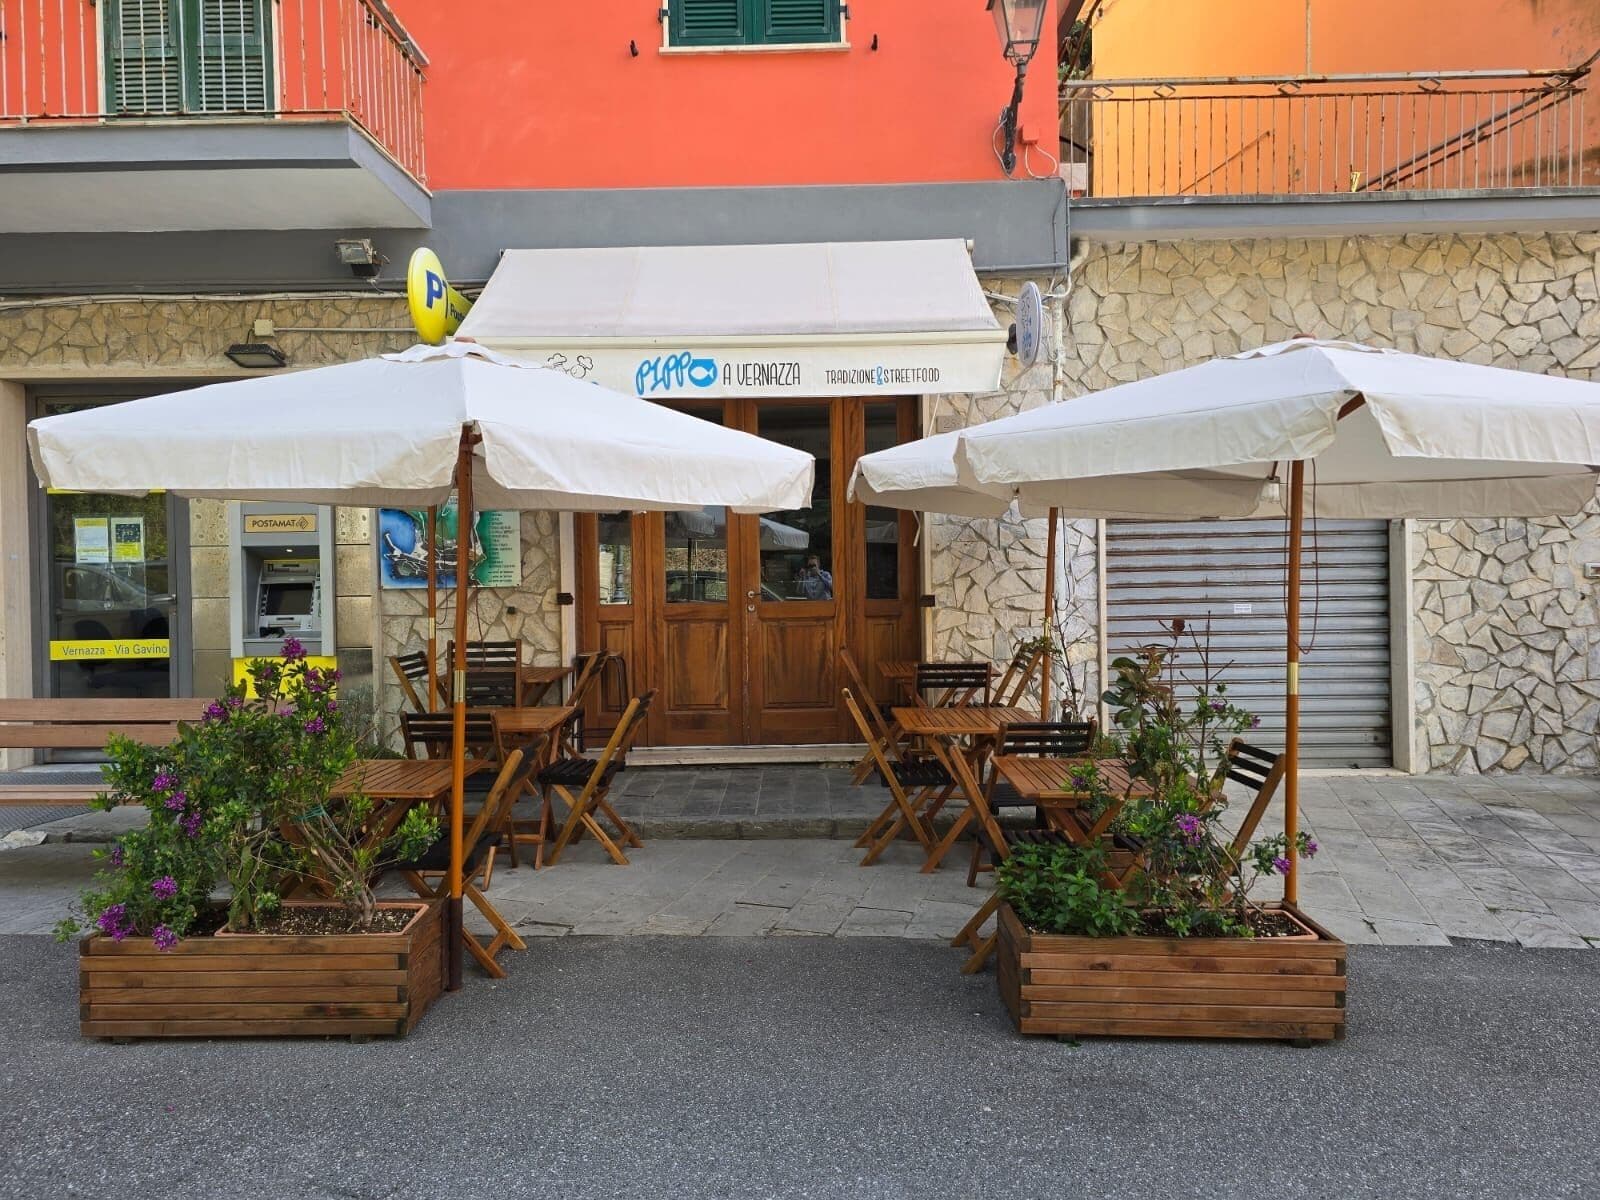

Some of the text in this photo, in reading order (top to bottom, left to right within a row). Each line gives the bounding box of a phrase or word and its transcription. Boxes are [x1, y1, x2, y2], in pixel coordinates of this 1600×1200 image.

[723, 363, 732, 385] A
[737, 362, 801, 386] VERNAZZA
[252, 519, 296, 528] POSTAMAT
[62, 645, 106, 656] Vernazza
[114, 643, 130, 654] Via
[133, 643, 168, 655] Gavino
